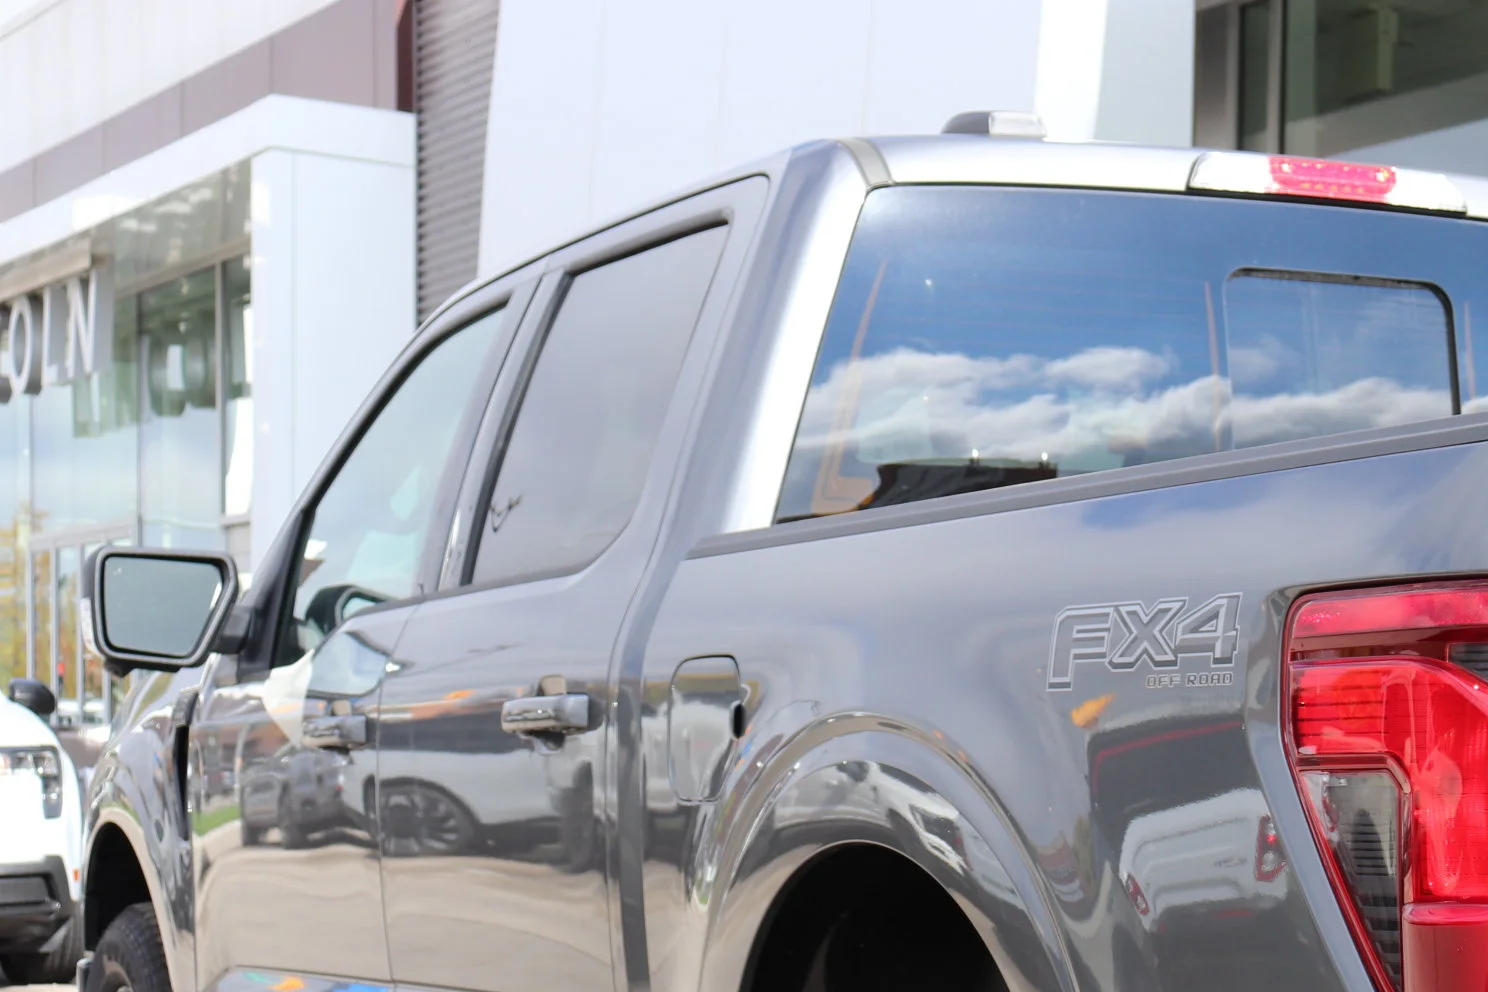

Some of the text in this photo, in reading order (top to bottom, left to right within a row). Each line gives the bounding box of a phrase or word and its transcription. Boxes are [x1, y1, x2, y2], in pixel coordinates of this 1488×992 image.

[1046, 591, 1243, 691] FX4
[1146, 671, 1234, 689] OFF ROAD
